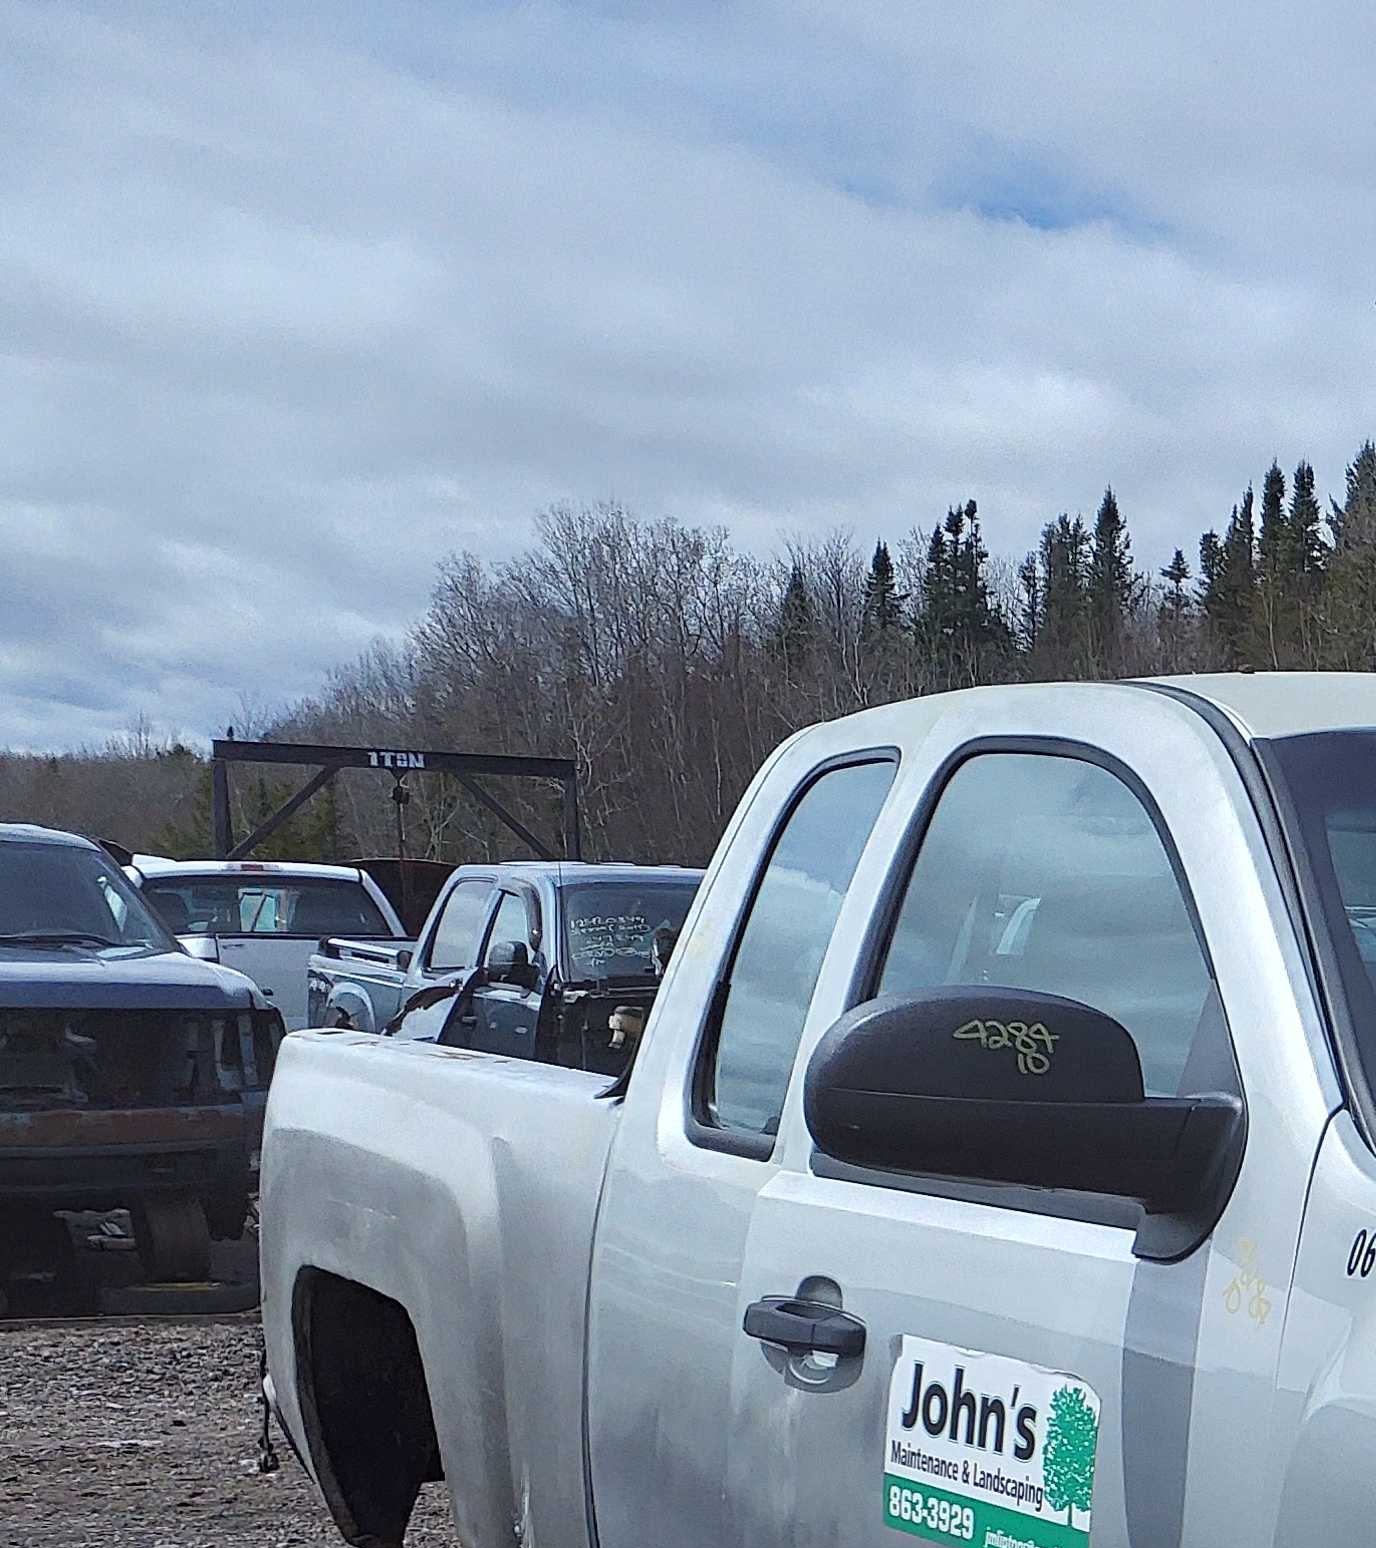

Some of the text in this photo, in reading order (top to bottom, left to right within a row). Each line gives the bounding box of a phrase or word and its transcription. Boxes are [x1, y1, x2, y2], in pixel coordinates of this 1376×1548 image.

[953, 1019, 1060, 1054] 4284
[1018, 1053, 1050, 1074] 10
[902, 1360, 1038, 1465] John's
[891, 1439, 1044, 1513] Maintenance & Landscaping
[888, 1485, 976, 1541] 863-3929
